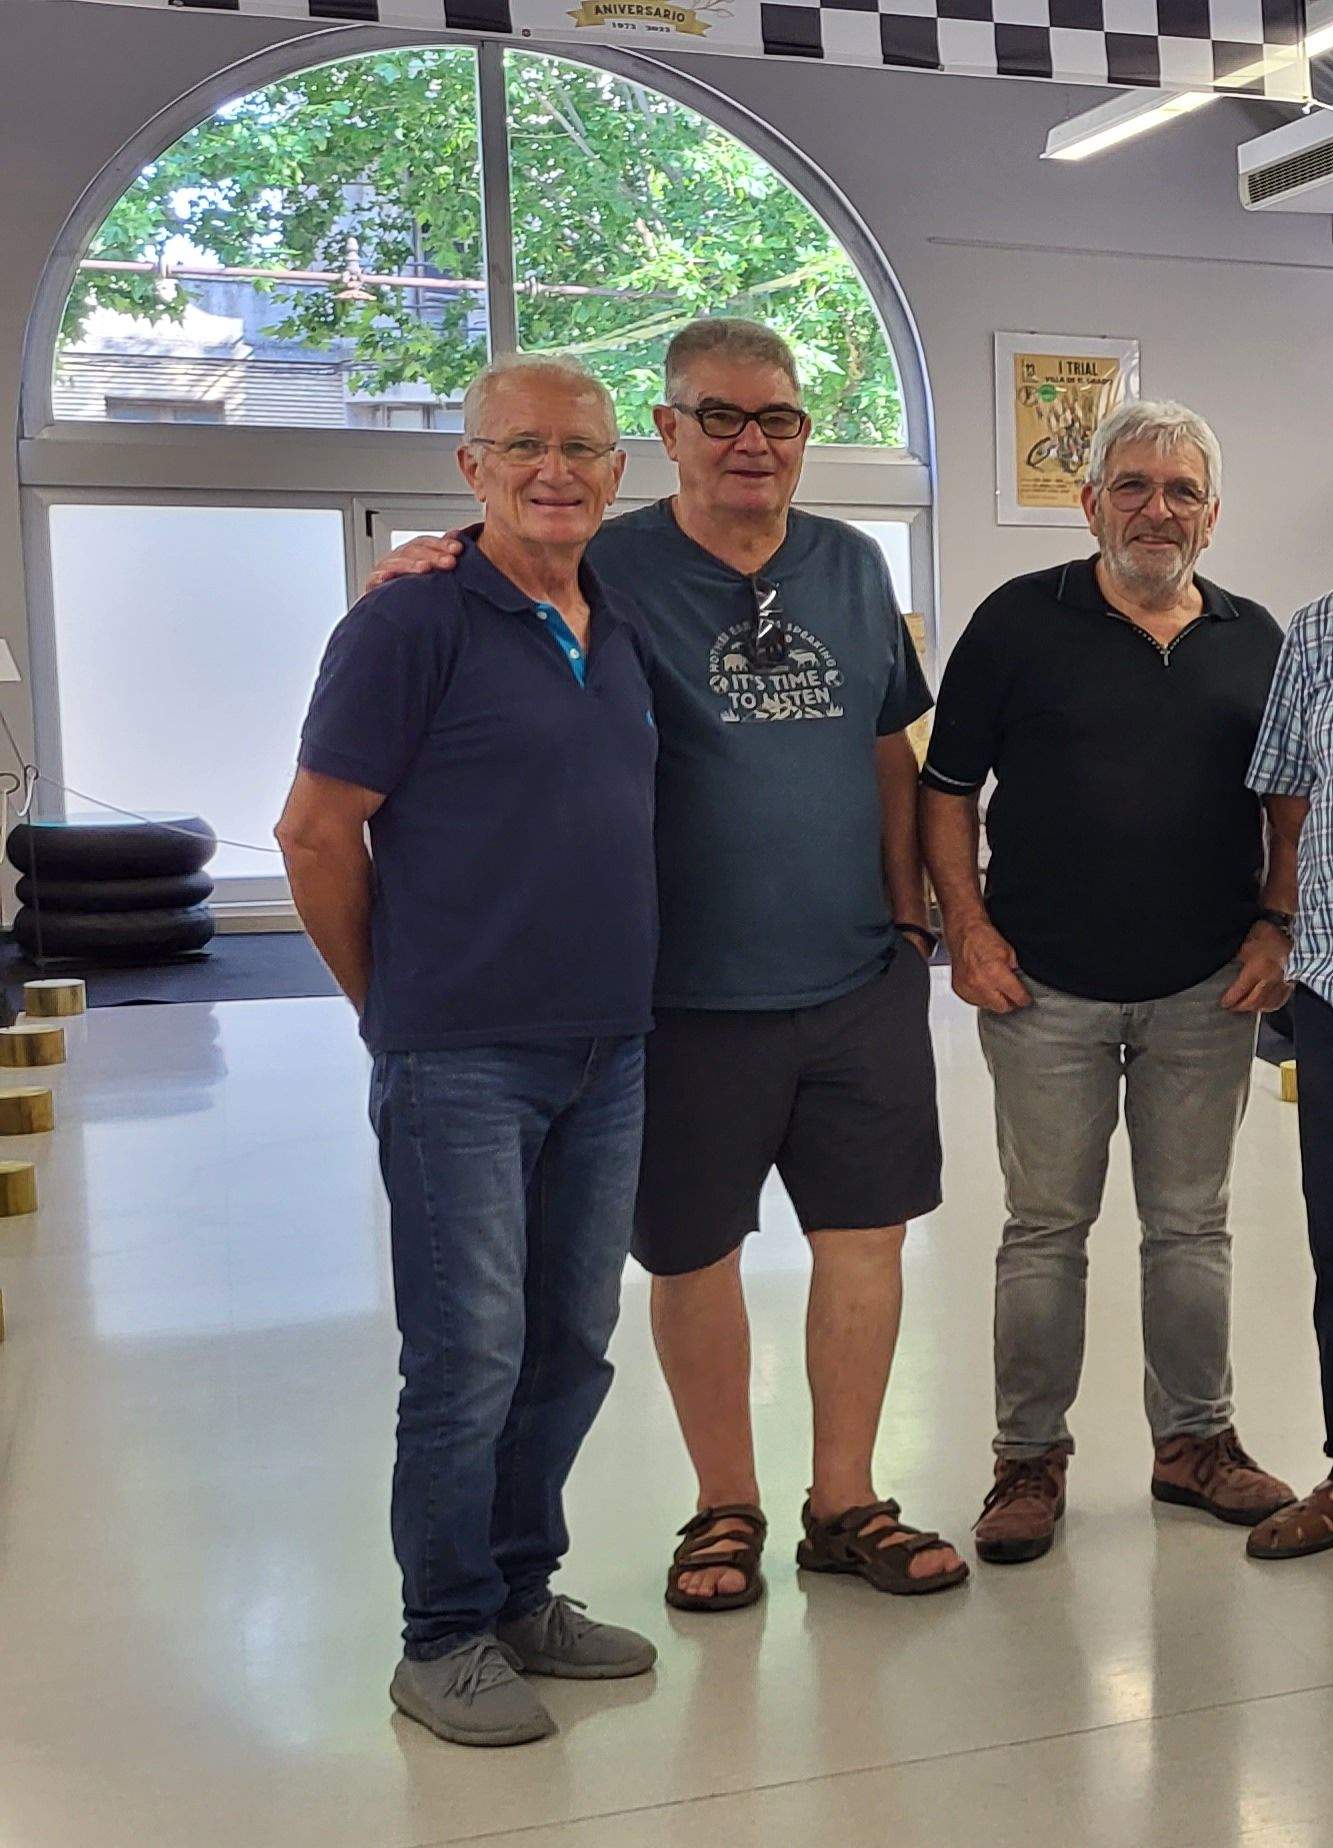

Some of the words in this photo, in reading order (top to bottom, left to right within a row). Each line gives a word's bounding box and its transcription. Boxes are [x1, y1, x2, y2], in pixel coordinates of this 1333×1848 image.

[594, 4, 686, 22] ANIVERSARIO
[1067, 361, 1098, 376] TRIAL
[731, 674, 766, 691] IT'S
[769, 670, 821, 691] TIME
[728, 692, 757, 709] TO
[763, 687, 831, 708] LISTEN
